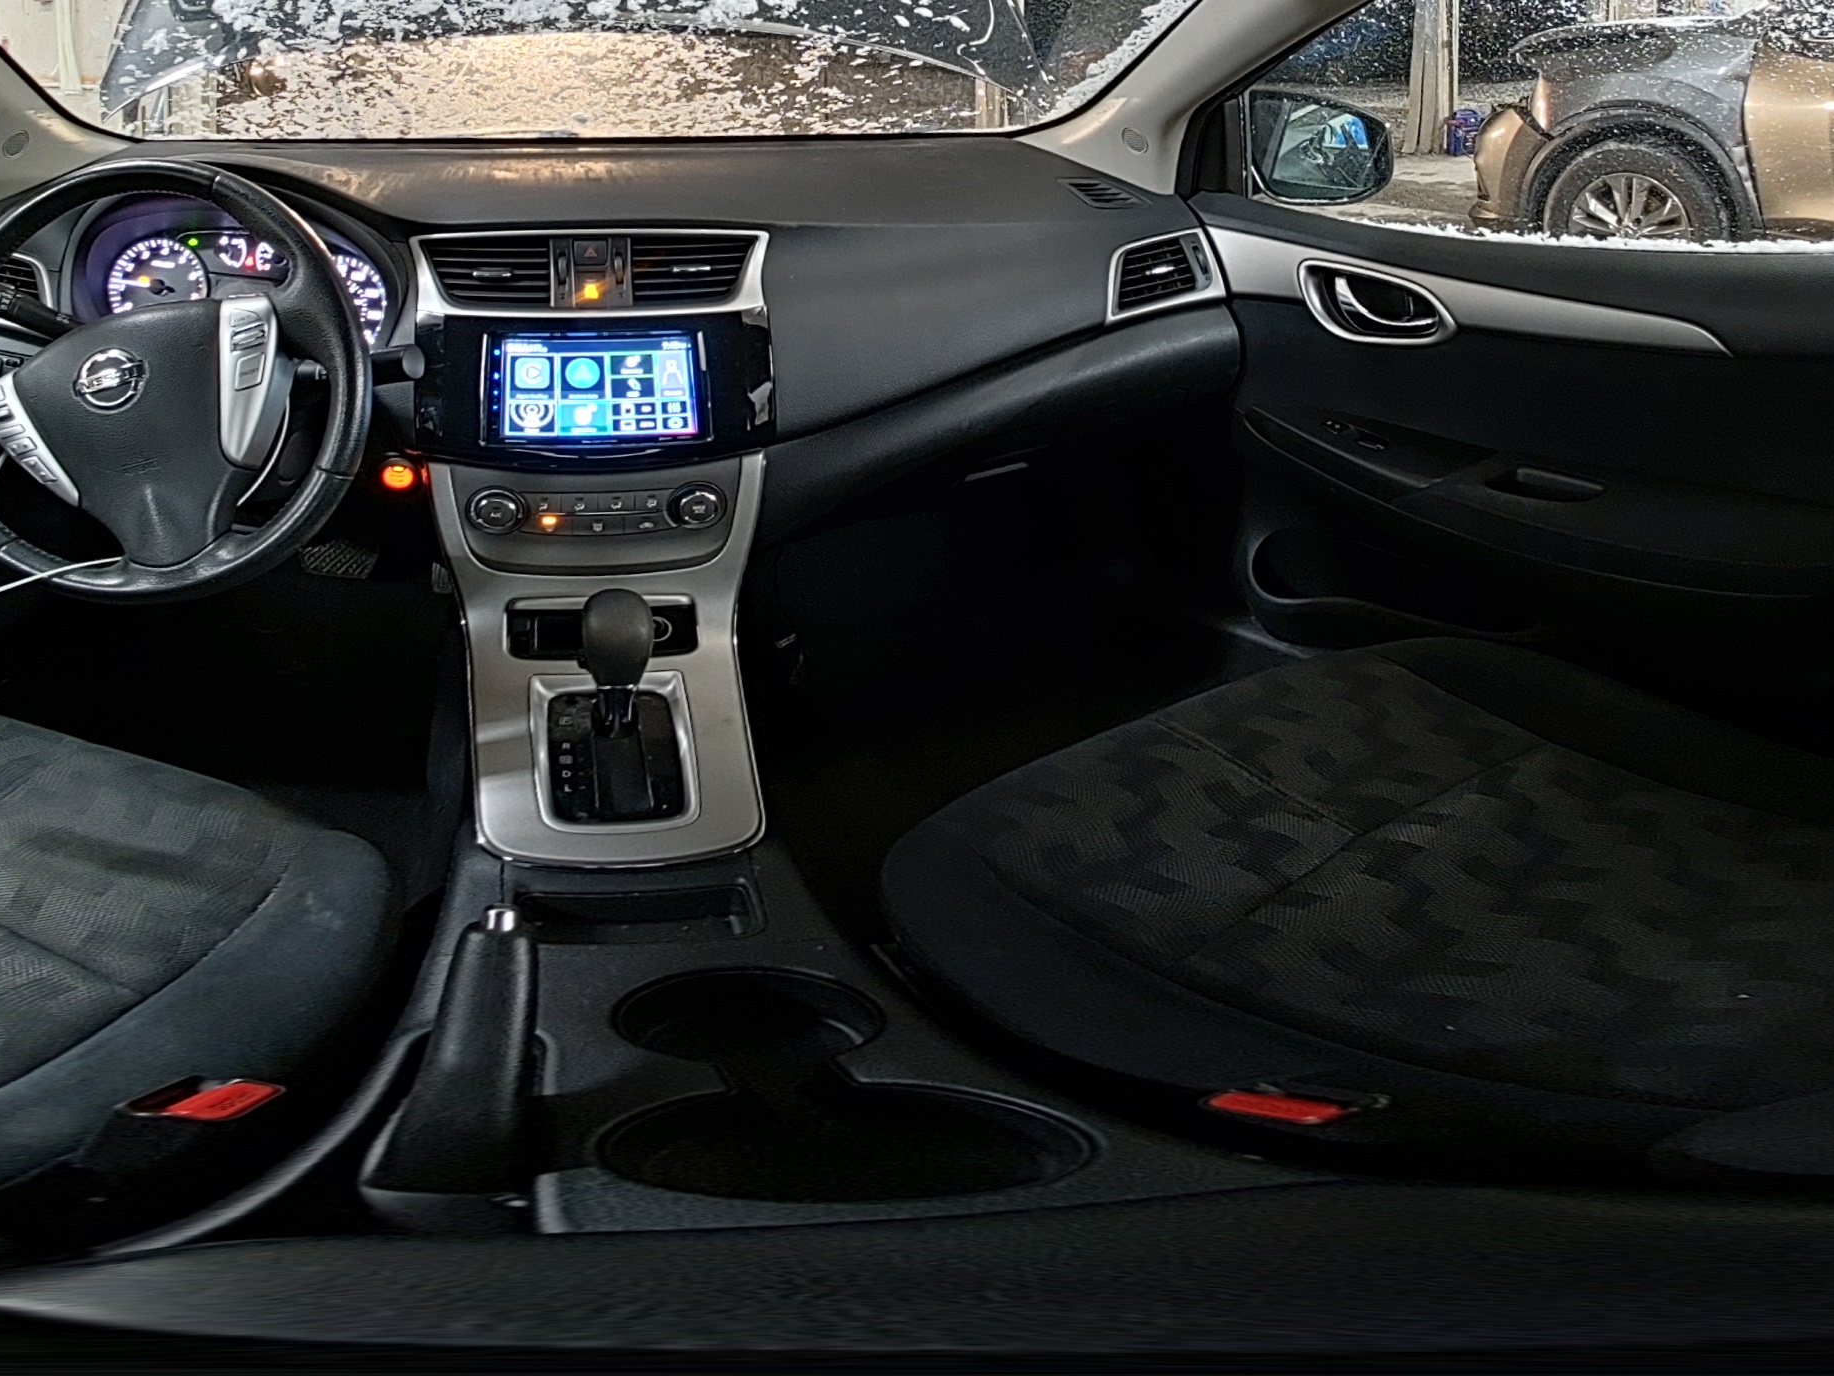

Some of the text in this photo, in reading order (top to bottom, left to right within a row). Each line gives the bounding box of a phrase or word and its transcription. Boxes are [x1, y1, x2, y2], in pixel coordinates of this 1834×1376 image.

[80, 366, 139, 391] NISSAN
[561, 769, 572, 778] D
[563, 784, 573, 793] L
